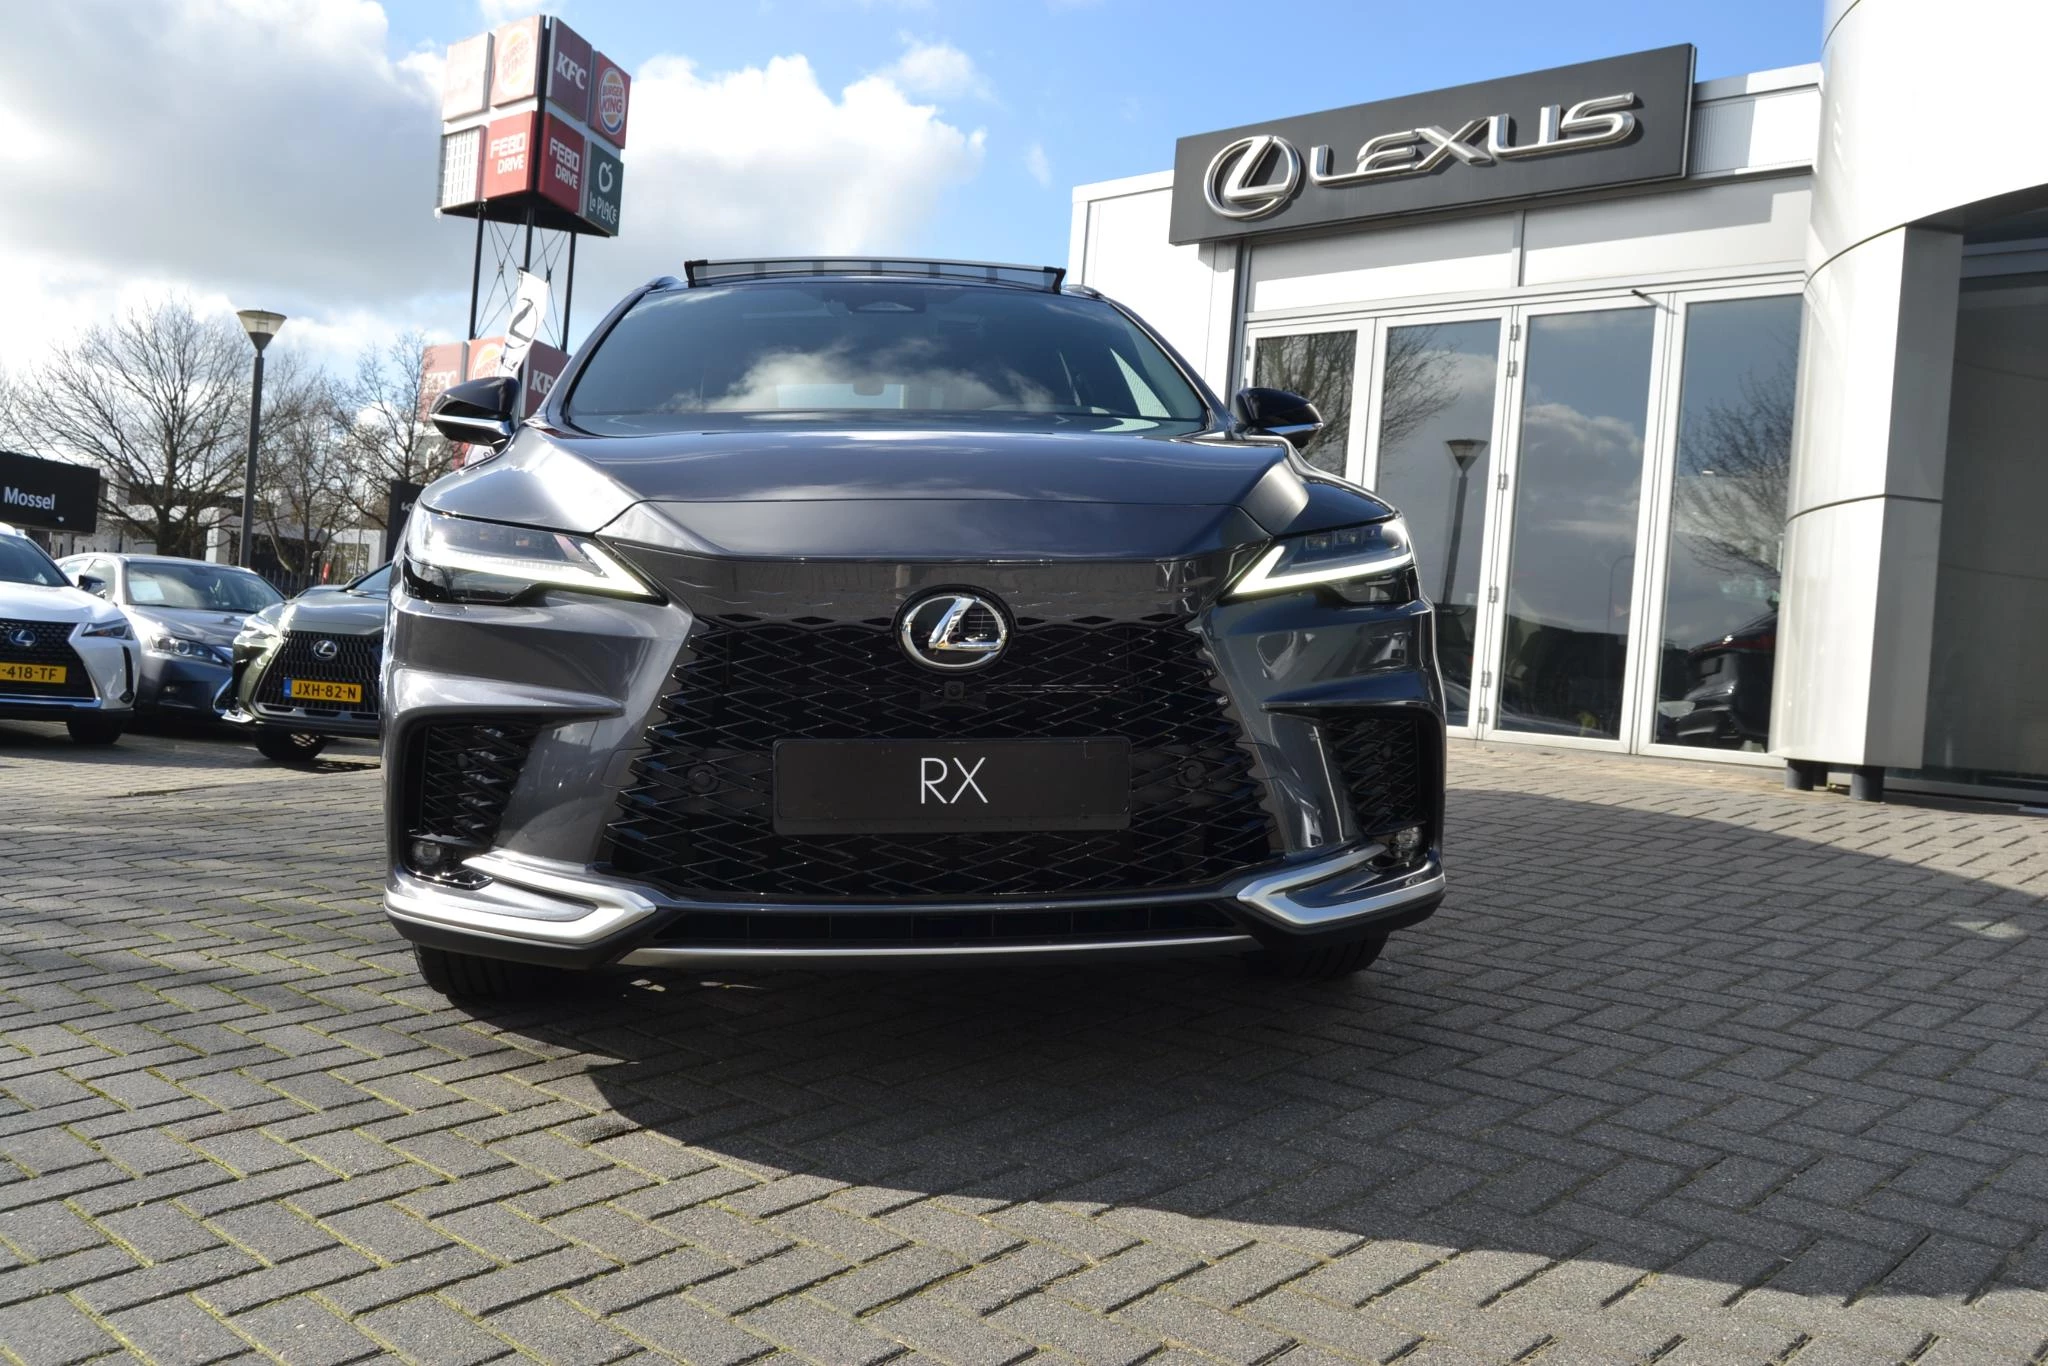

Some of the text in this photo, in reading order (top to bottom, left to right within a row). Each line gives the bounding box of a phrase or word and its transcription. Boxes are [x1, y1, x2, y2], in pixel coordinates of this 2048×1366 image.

[556, 51, 587, 90] KFC
[602, 85, 623, 98] BURGER
[602, 95, 623, 114] KING
[490, 133, 525, 159] FEBO
[1309, 91, 1636, 187] LEXUS
[498, 156, 524, 174] DRIVE
[549, 137, 579, 170] FEBO
[555, 164, 578, 189] DRIVE
[530, 370, 555, 394] KF
[3, 486, 56, 511] Mossel
[296, 683, 356, 700] JXH-82-N
[920, 757, 989, 804] RX
